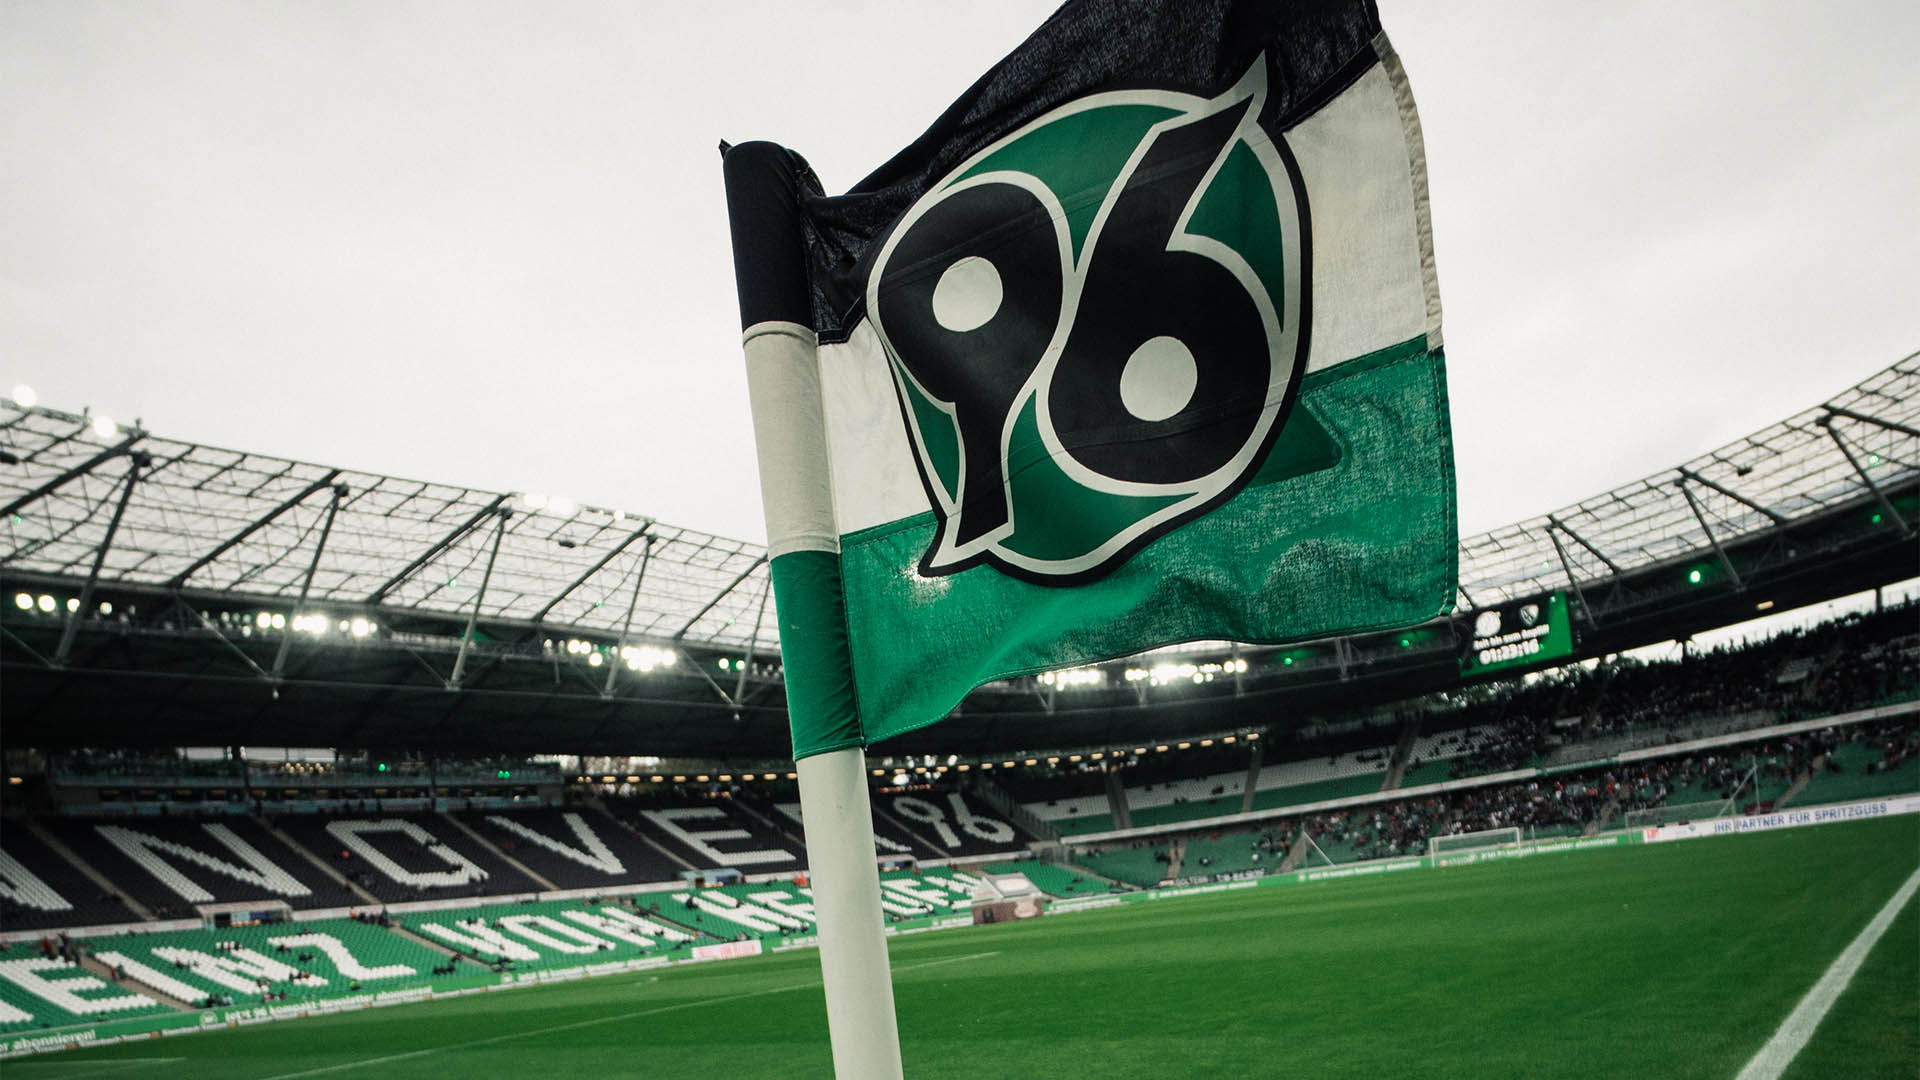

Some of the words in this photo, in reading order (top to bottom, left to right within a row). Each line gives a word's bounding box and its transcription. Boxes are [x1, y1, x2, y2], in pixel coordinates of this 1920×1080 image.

[876, 92, 1274, 549] 96
[892, 794, 1015, 848] 96
[1714, 821, 1732, 833] IHR
[1735, 815, 1785, 830] PARTNER
[1815, 803, 1888, 822] SPRITZGUSS
